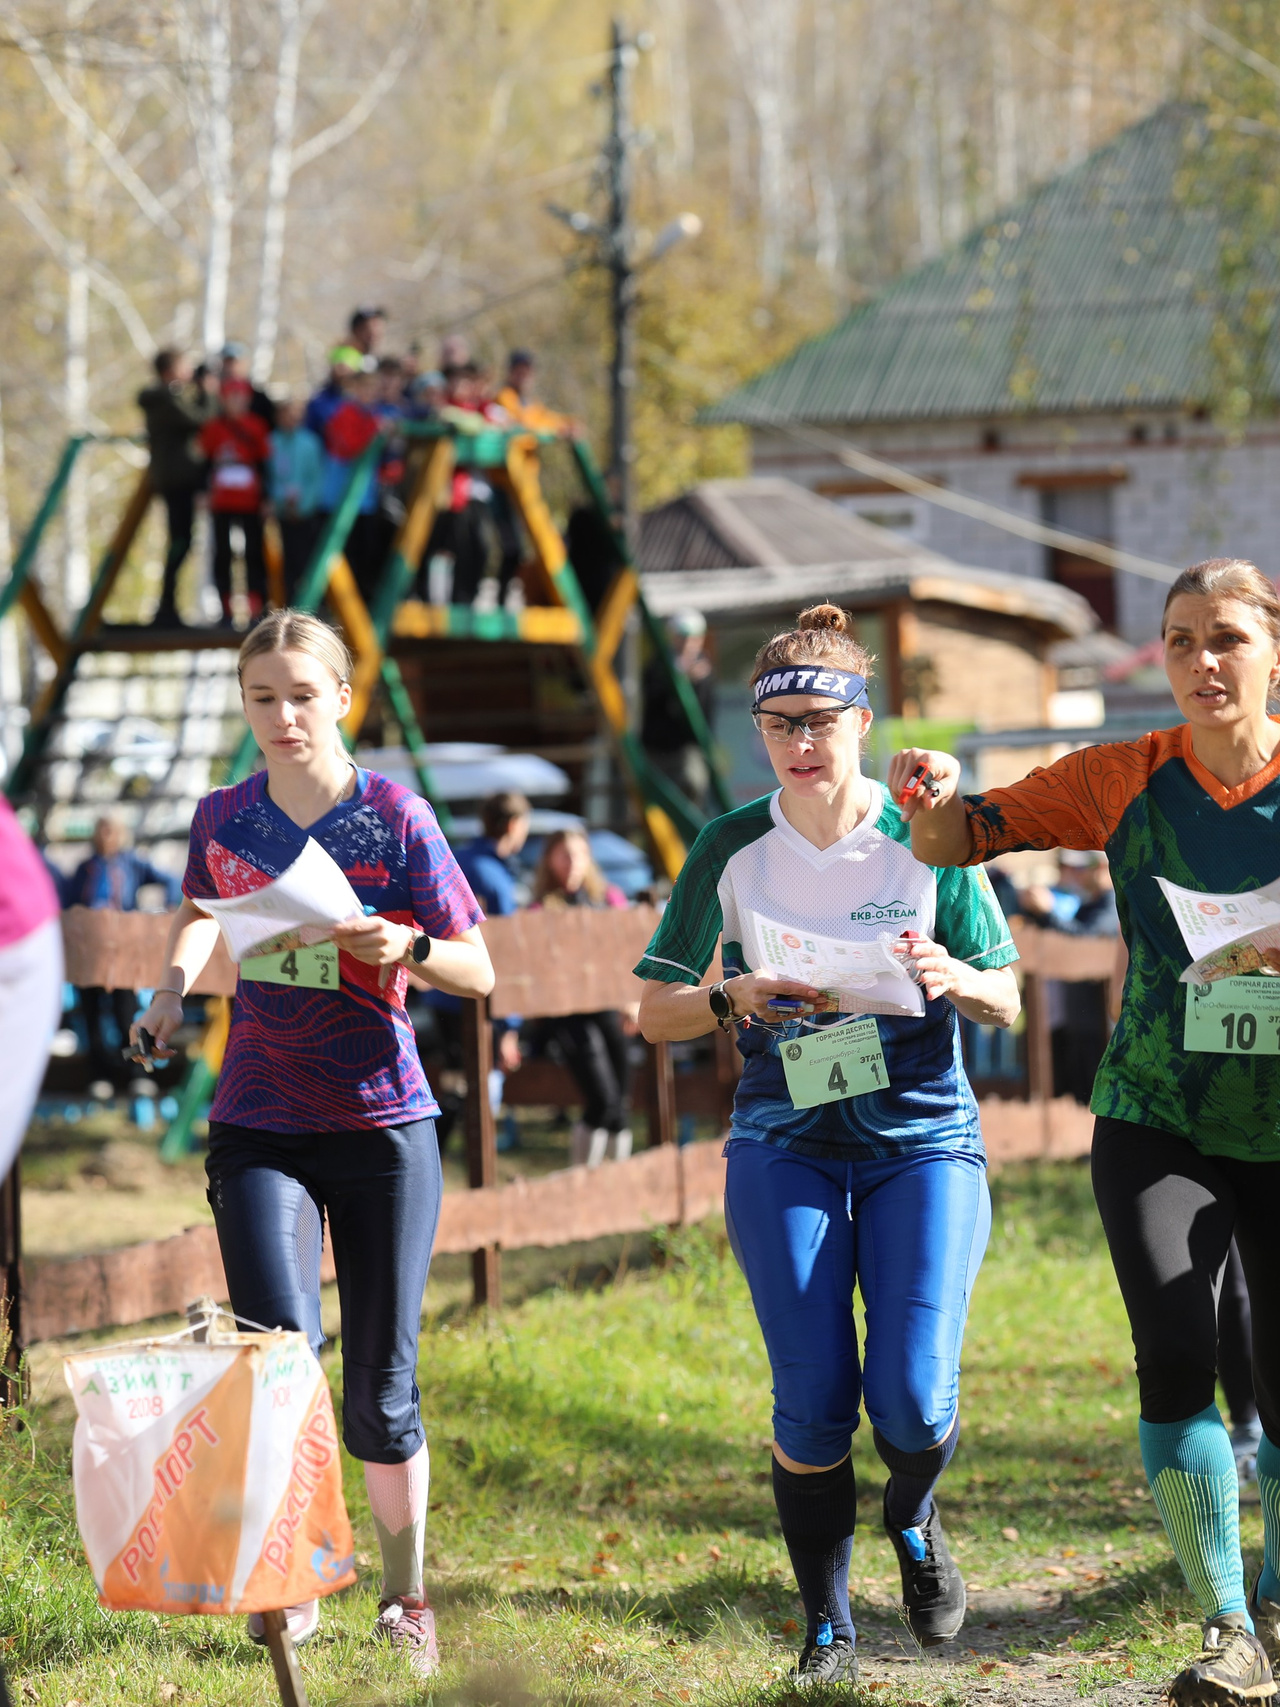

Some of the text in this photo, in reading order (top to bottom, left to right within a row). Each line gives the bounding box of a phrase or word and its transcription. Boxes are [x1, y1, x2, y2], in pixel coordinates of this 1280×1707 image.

[850, 909, 917, 920] EKB-O-TEAM
[280, 950, 299, 982] 4
[320, 962, 329, 985] 2
[1230, 980, 1261, 988] ГОРЯЧАЯ
[816, 1022, 875, 1042] ГОРЯЧАЯ ДЕСЯТКА
[1221, 1012, 1257, 1051] 10
[809, 1047, 861, 1066] Екатеринбург-2
[860, 1053, 882, 1064] ЭТАП
[828, 1061, 848, 1095] 4
[870, 1062, 881, 1086] 1
